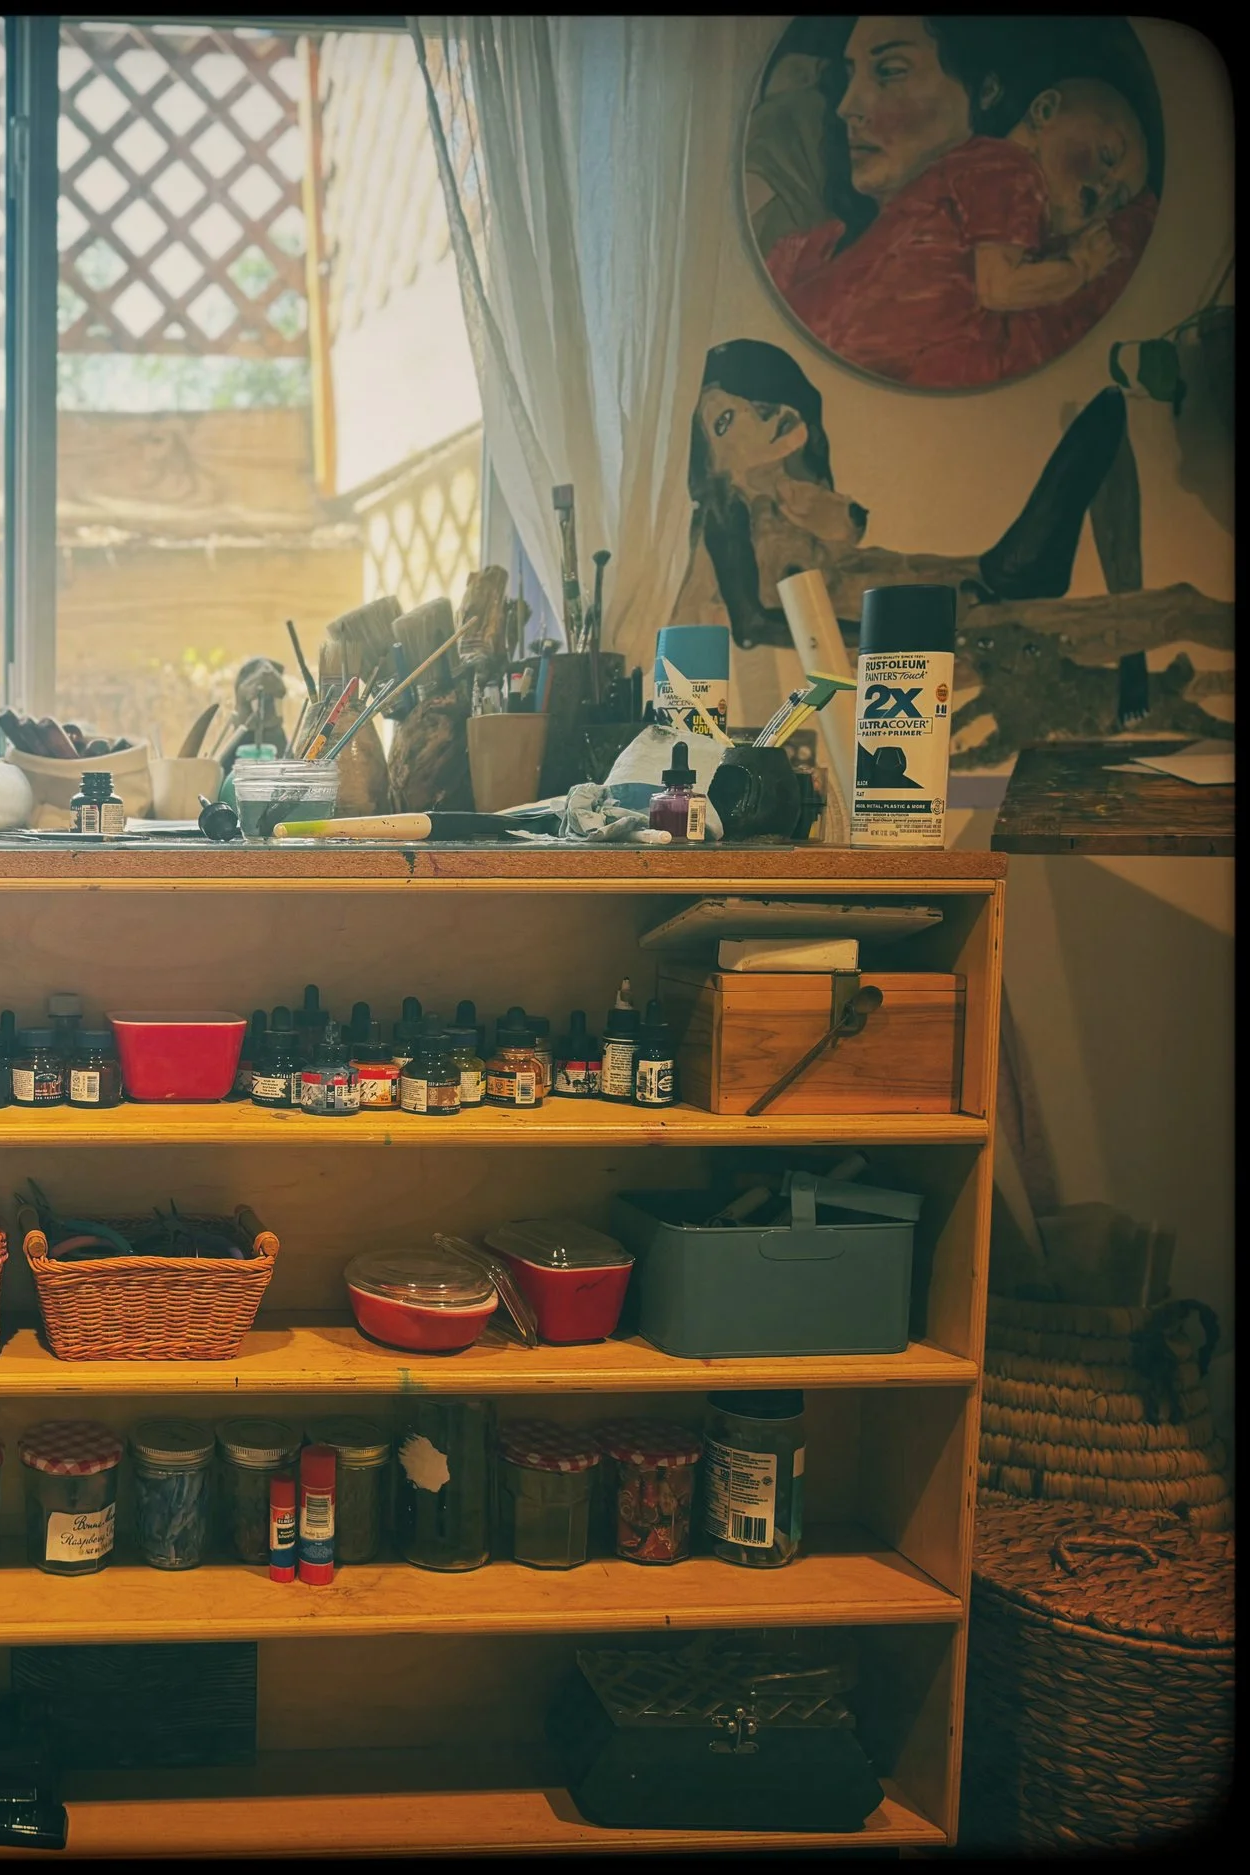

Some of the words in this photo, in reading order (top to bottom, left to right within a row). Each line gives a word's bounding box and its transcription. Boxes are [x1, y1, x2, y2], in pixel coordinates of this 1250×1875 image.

[865, 659, 927, 672] RUST-OLEUM
[898, 670, 926, 680] Touch
[863, 683, 924, 719] 2X
[859, 719, 927, 730] ULTRACOVER
[327, 1090, 335, 1103] INK
